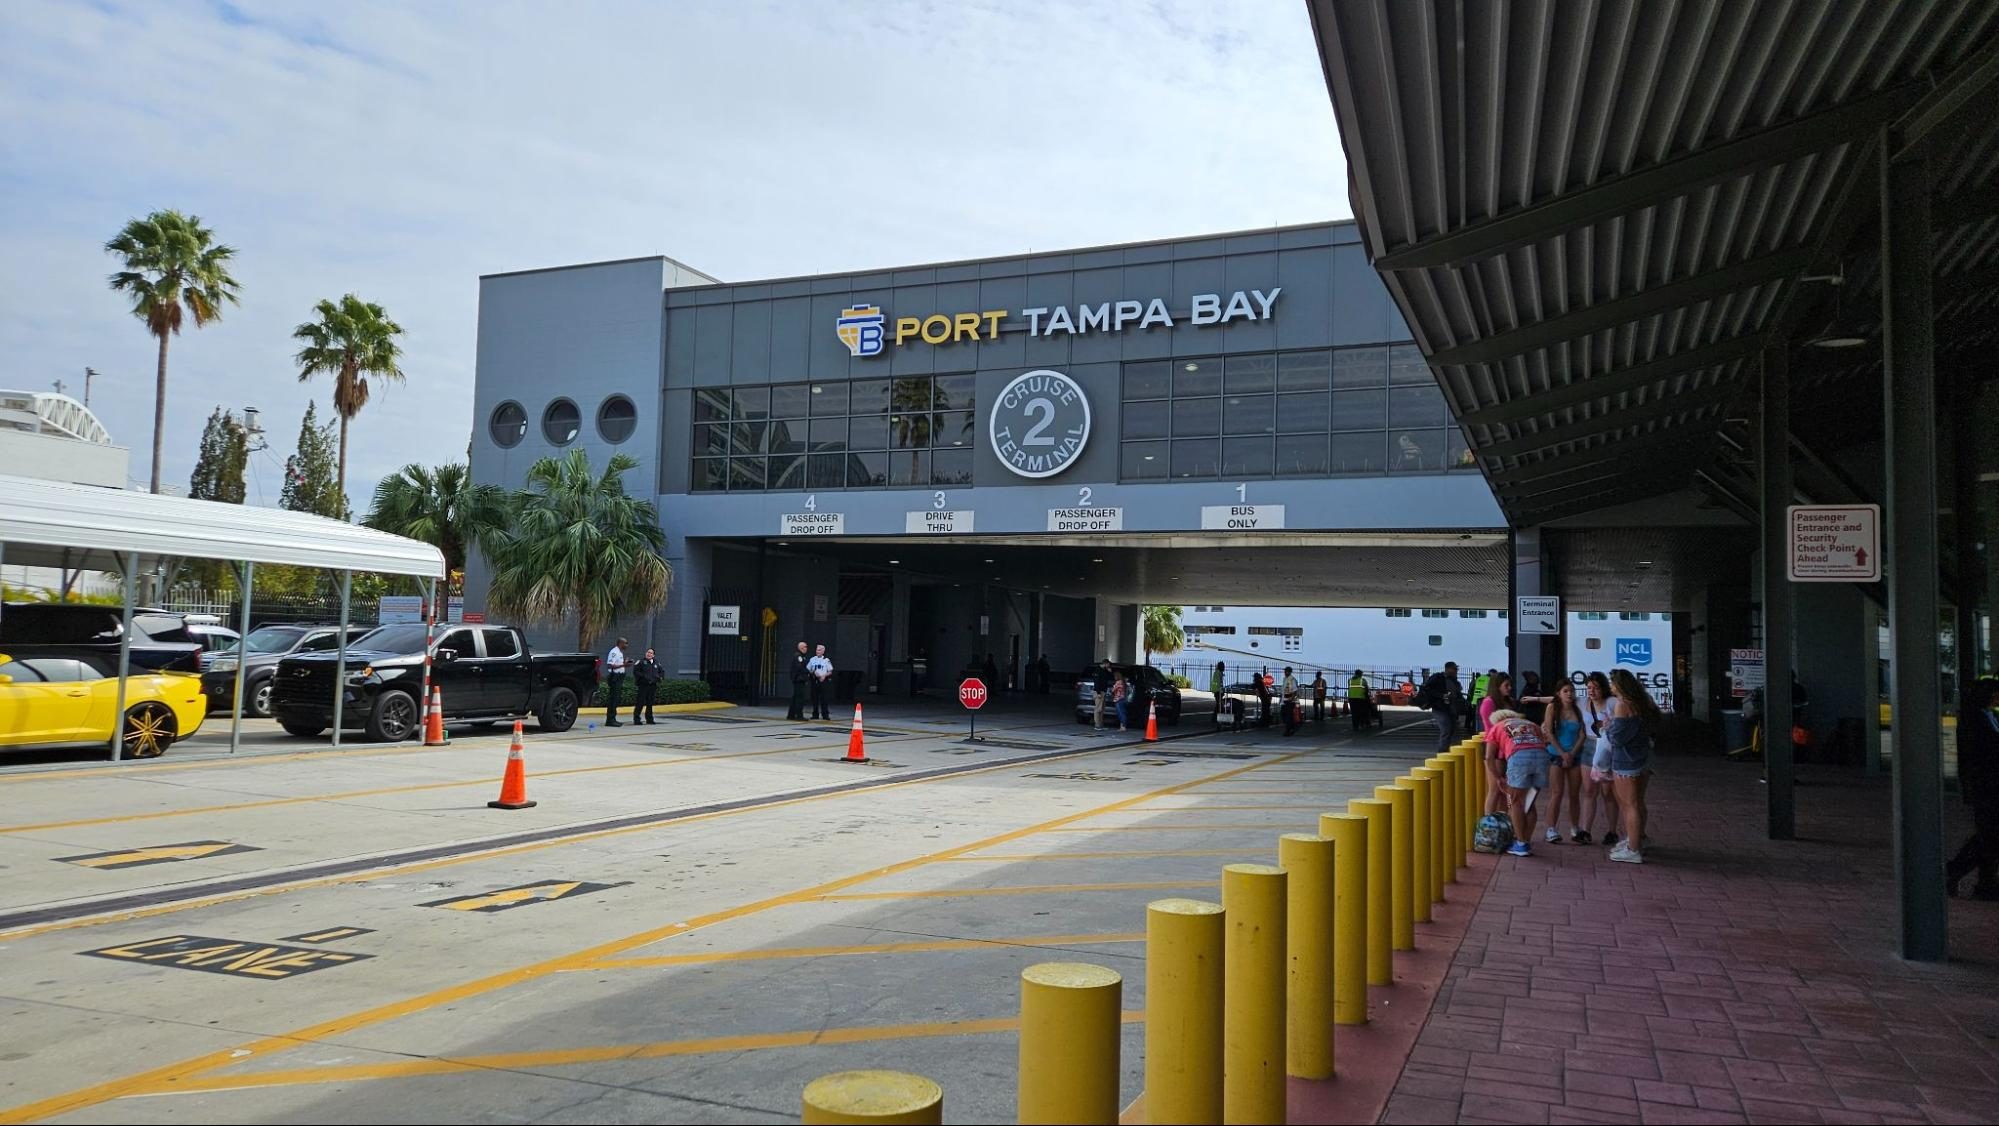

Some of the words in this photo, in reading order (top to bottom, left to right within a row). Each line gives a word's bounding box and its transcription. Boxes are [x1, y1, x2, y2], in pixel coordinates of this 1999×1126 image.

[895, 310, 1008, 346] PORT
[1022, 298, 1174, 337] TAMPA
[1191, 287, 1282, 325] BAY
[1003, 377, 1078, 409] CRUISE
[1022, 397, 1056, 446] 2
[996, 423, 1084, 471] TERMINAL
[1078, 486, 1092, 506] 2
[1235, 483, 1247, 503] 1
[804, 494, 817, 511] 4
[933, 490, 946, 509] 3
[1054, 509, 1116, 518] PASSENGER
[1231, 507, 1255, 516] BUS
[786, 514, 839, 523] PASSENGER
[925, 512, 954, 521] DRIVE
[1797, 514, 1847, 523] Passenger
[927, 523, 953, 532] THRU
[1058, 521, 1088, 530] DROP
[1090, 521, 1111, 530] OFF
[1227, 519, 1259, 529] ONLY
[1797, 523, 1840, 531] Entrance
[1843, 523, 1862, 531] and
[790, 526, 815, 534] DROP
[817, 525, 835, 533] OFF
[1797, 533, 1838, 543] Security
[1797, 544, 1825, 552] Check
[1829, 544, 1856, 552] Point
[1797, 554, 1828, 562] Ahead
[711, 621, 737, 629] AVAILABLE
[1618, 643, 1650, 654] NCL
[1731, 650, 1764, 659] NOTIC
[961, 687, 985, 700] STOP
[97, 937, 356, 977] LANE
